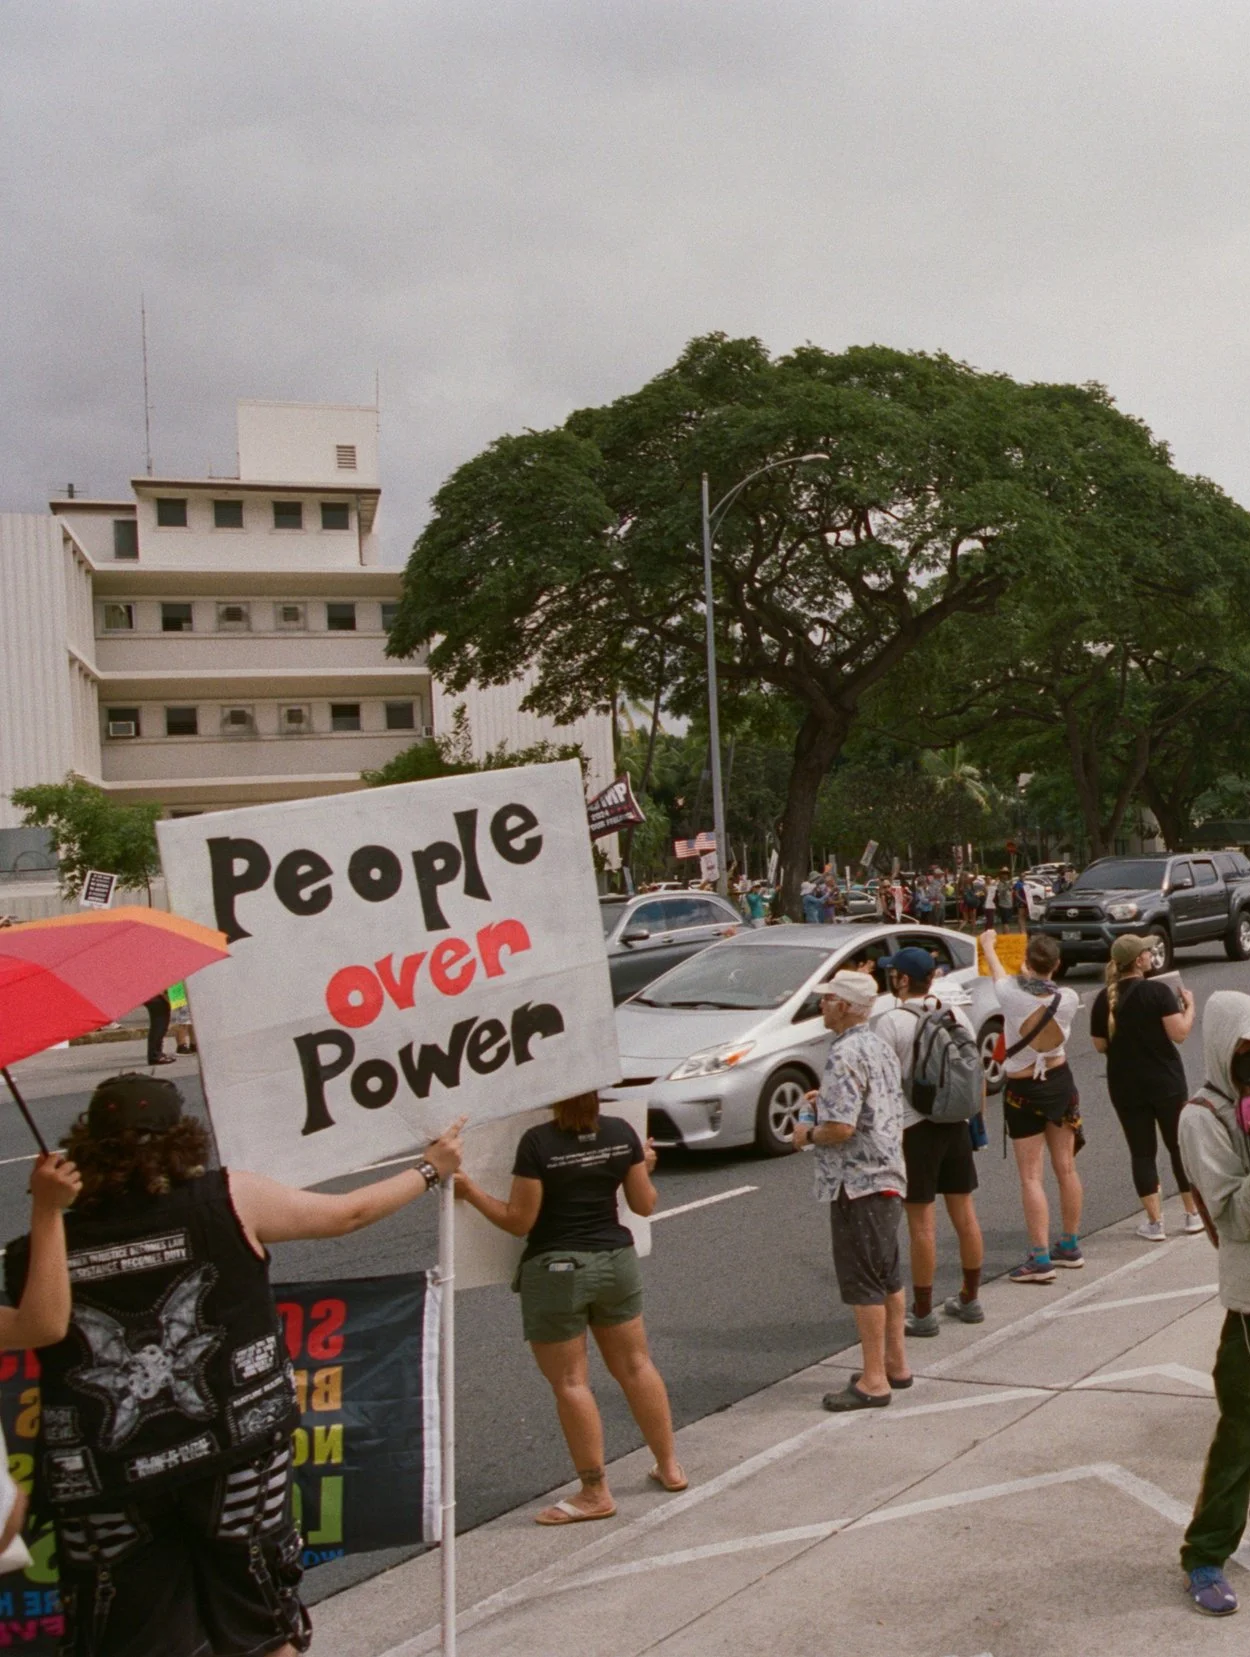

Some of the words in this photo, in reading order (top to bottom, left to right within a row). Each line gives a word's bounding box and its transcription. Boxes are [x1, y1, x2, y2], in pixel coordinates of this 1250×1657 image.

[206, 802, 543, 943] People
[325, 918, 532, 1028] over
[293, 1000, 565, 1136] Power
[164, 1247, 187, 1261] DUTY
